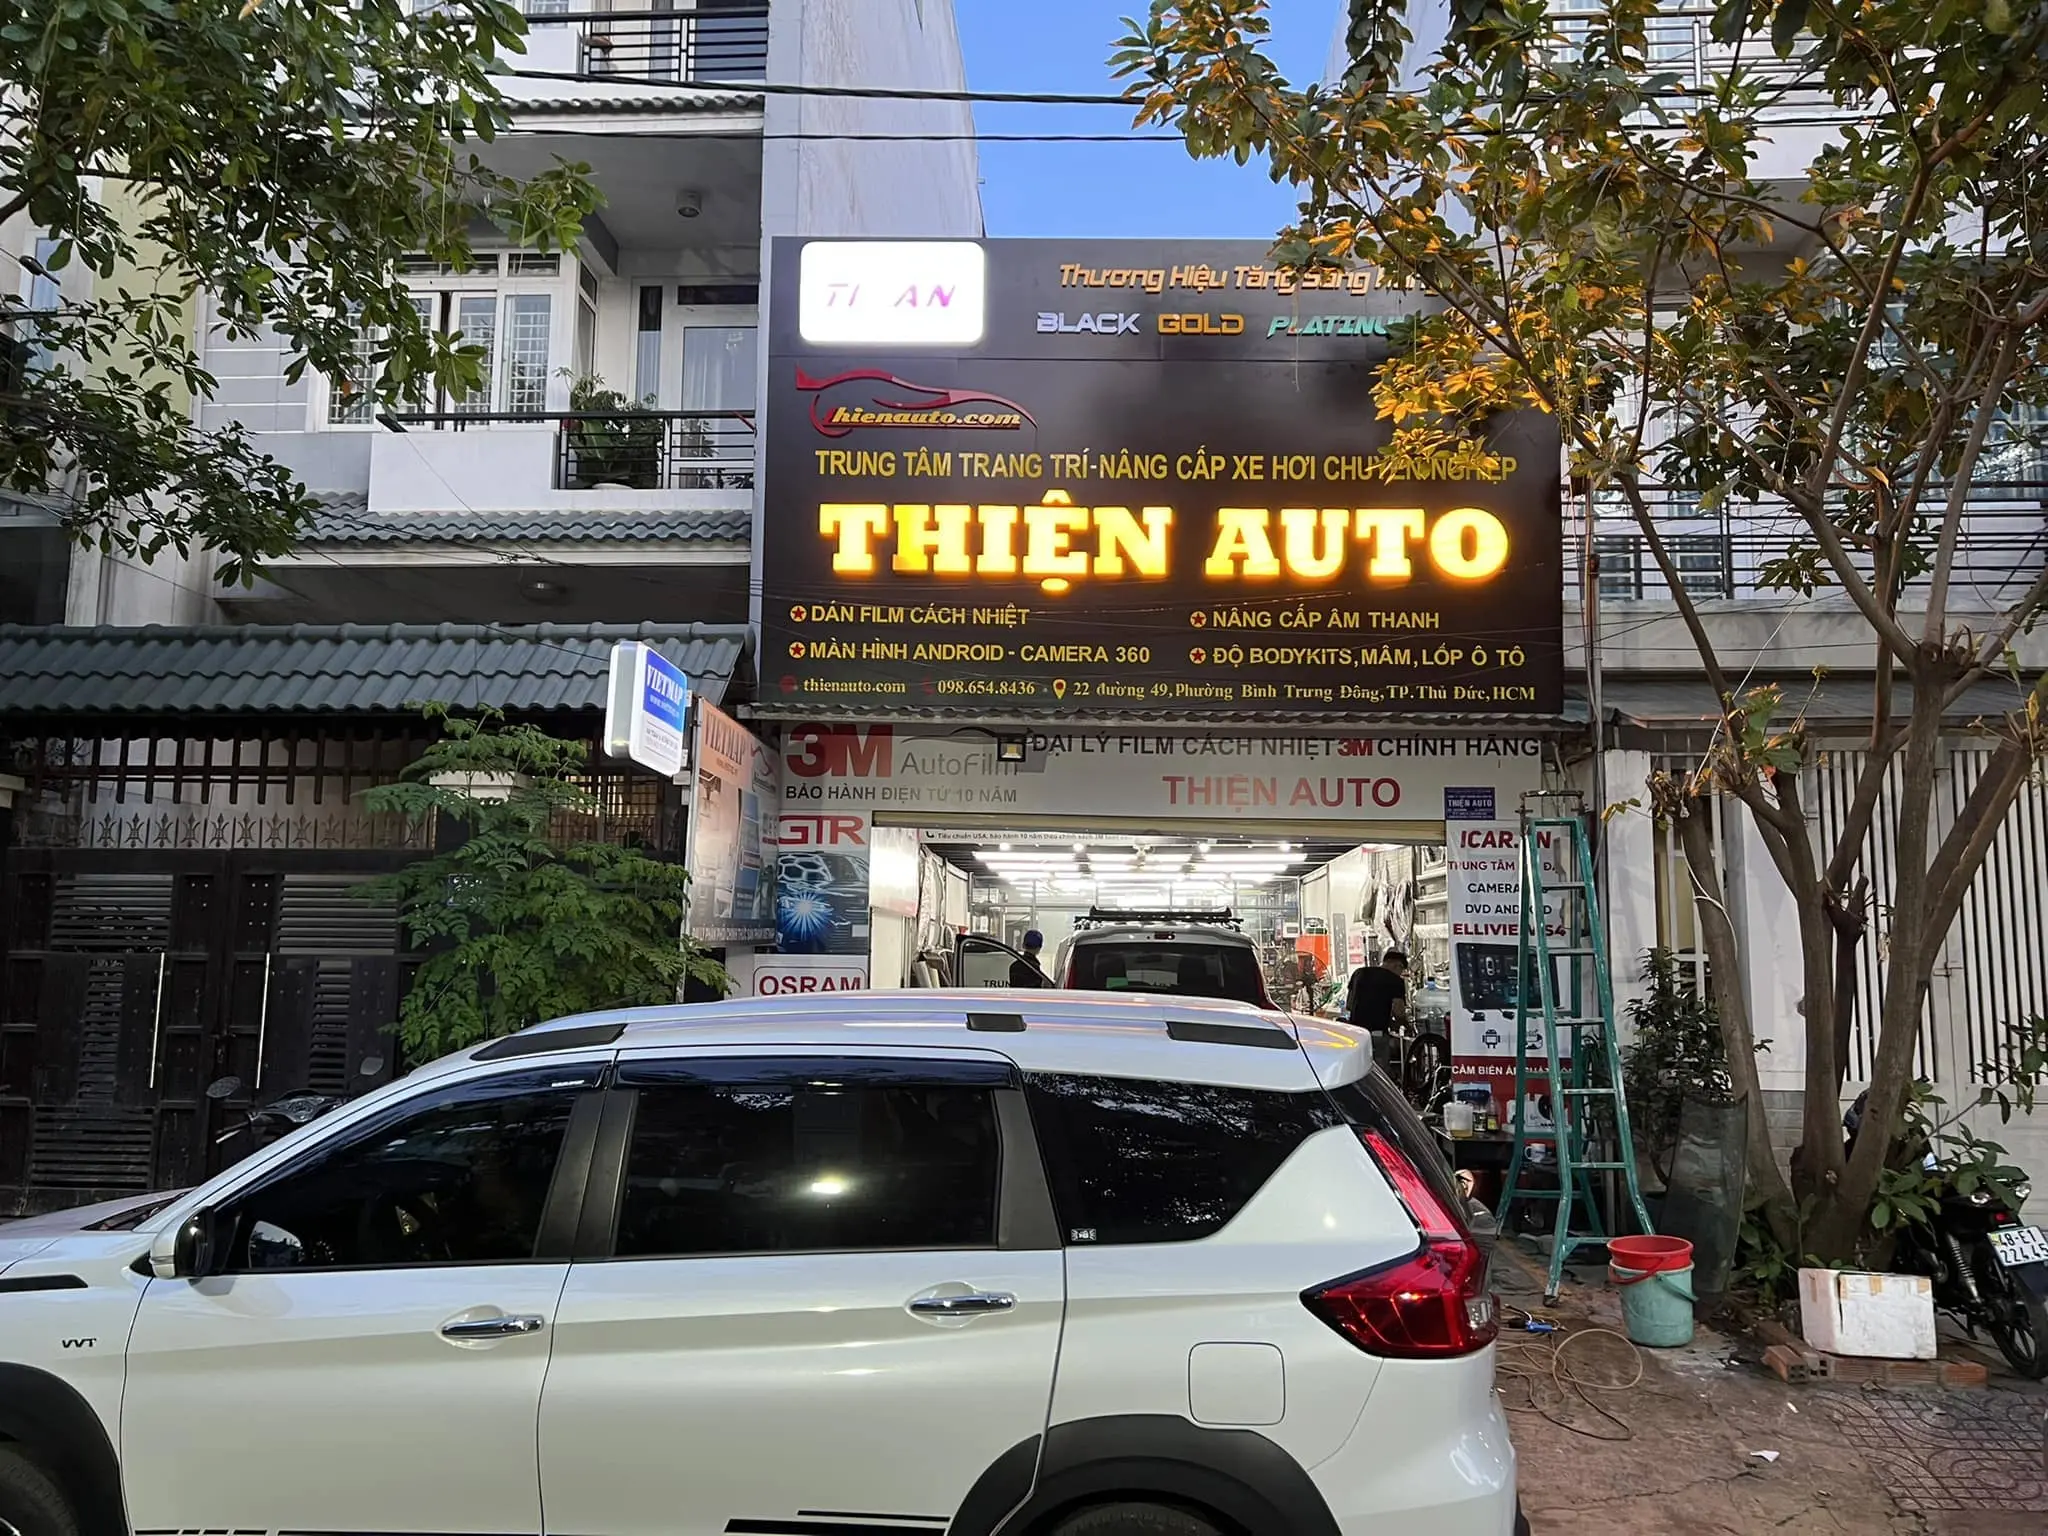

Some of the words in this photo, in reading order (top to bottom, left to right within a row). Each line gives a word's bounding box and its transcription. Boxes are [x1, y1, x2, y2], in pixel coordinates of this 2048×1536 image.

[1060, 263, 1165, 294] Thương
[1169, 263, 1228, 293] Hiệu
[1233, 265, 1297, 296] Tăng
[1036, 312, 1141, 336] BLACK
[1157, 312, 1245, 336] GOLD
[1267, 314, 1405, 340] PLATINU
[815, 450, 896, 478] TRUNG
[903, 446, 952, 478] TÂM
[958, 452, 1043, 479] TRANG
[1176, 445, 1226, 480] CẤP
[1231, 455, 1264, 480] XE
[1272, 454, 1316, 480] HƠI
[818, 488, 1173, 592] THIỆN
[1204, 505, 1510, 580] AUTO
[811, 602, 854, 624] DÁN
[860, 605, 904, 624] FILM
[910, 602, 966, 625] CÁCH
[972, 602, 1030, 629] NHIỆT
[1212, 607, 1272, 629] NÂNG
[1279, 603, 1321, 628] CẤP
[1327, 607, 1360, 629] ÂM
[1367, 611, 1440, 629] THANH
[810, 641, 856, 660] MÀN
[861, 640, 908, 662] HÌNH
[913, 643, 1004, 662] ANDROID
[1020, 645, 1109, 664] CAMERA
[1115, 646, 1151, 664] 360
[1212, 644, 1244, 669] ĐỘ
[1471, 645, 1488, 667] Ô
[1496, 645, 1526, 667] TÔ
[803, 677, 906, 694] thienauto.com
[937, 680, 1036, 696] 098.654.8436
[1072, 681, 1090, 696] 22
[1096, 680, 1145, 701] đường
[1283, 684, 1333, 702] Trưng
[786, 722, 893, 778] 3M
[1081, 730, 1111, 753] LÝ
[1118, 736, 1174, 756] FILM
[1181, 732, 1252, 757] CÁCH
[1376, 732, 1457, 758] CHÍNH
[1465, 733, 1540, 758] HÃNG
[785, 783, 823, 801] BẢO
[828, 784, 876, 802] HÀNH
[958, 788, 974, 803] 10
[1161, 773, 1277, 814] THIỆN
[1288, 776, 1402, 808] AUTO
[1472, 799, 1493, 808] AUTO
[778, 815, 866, 845] GTR
[1460, 830, 1552, 849] ICAR.N
[1467, 882, 1520, 894] CAMERA
[1465, 903, 1492, 914] DVD
[1495, 904, 1552, 914] ANDD
[758, 975, 861, 997] OSRAM
[61, 1338, 97, 1349] VVT
